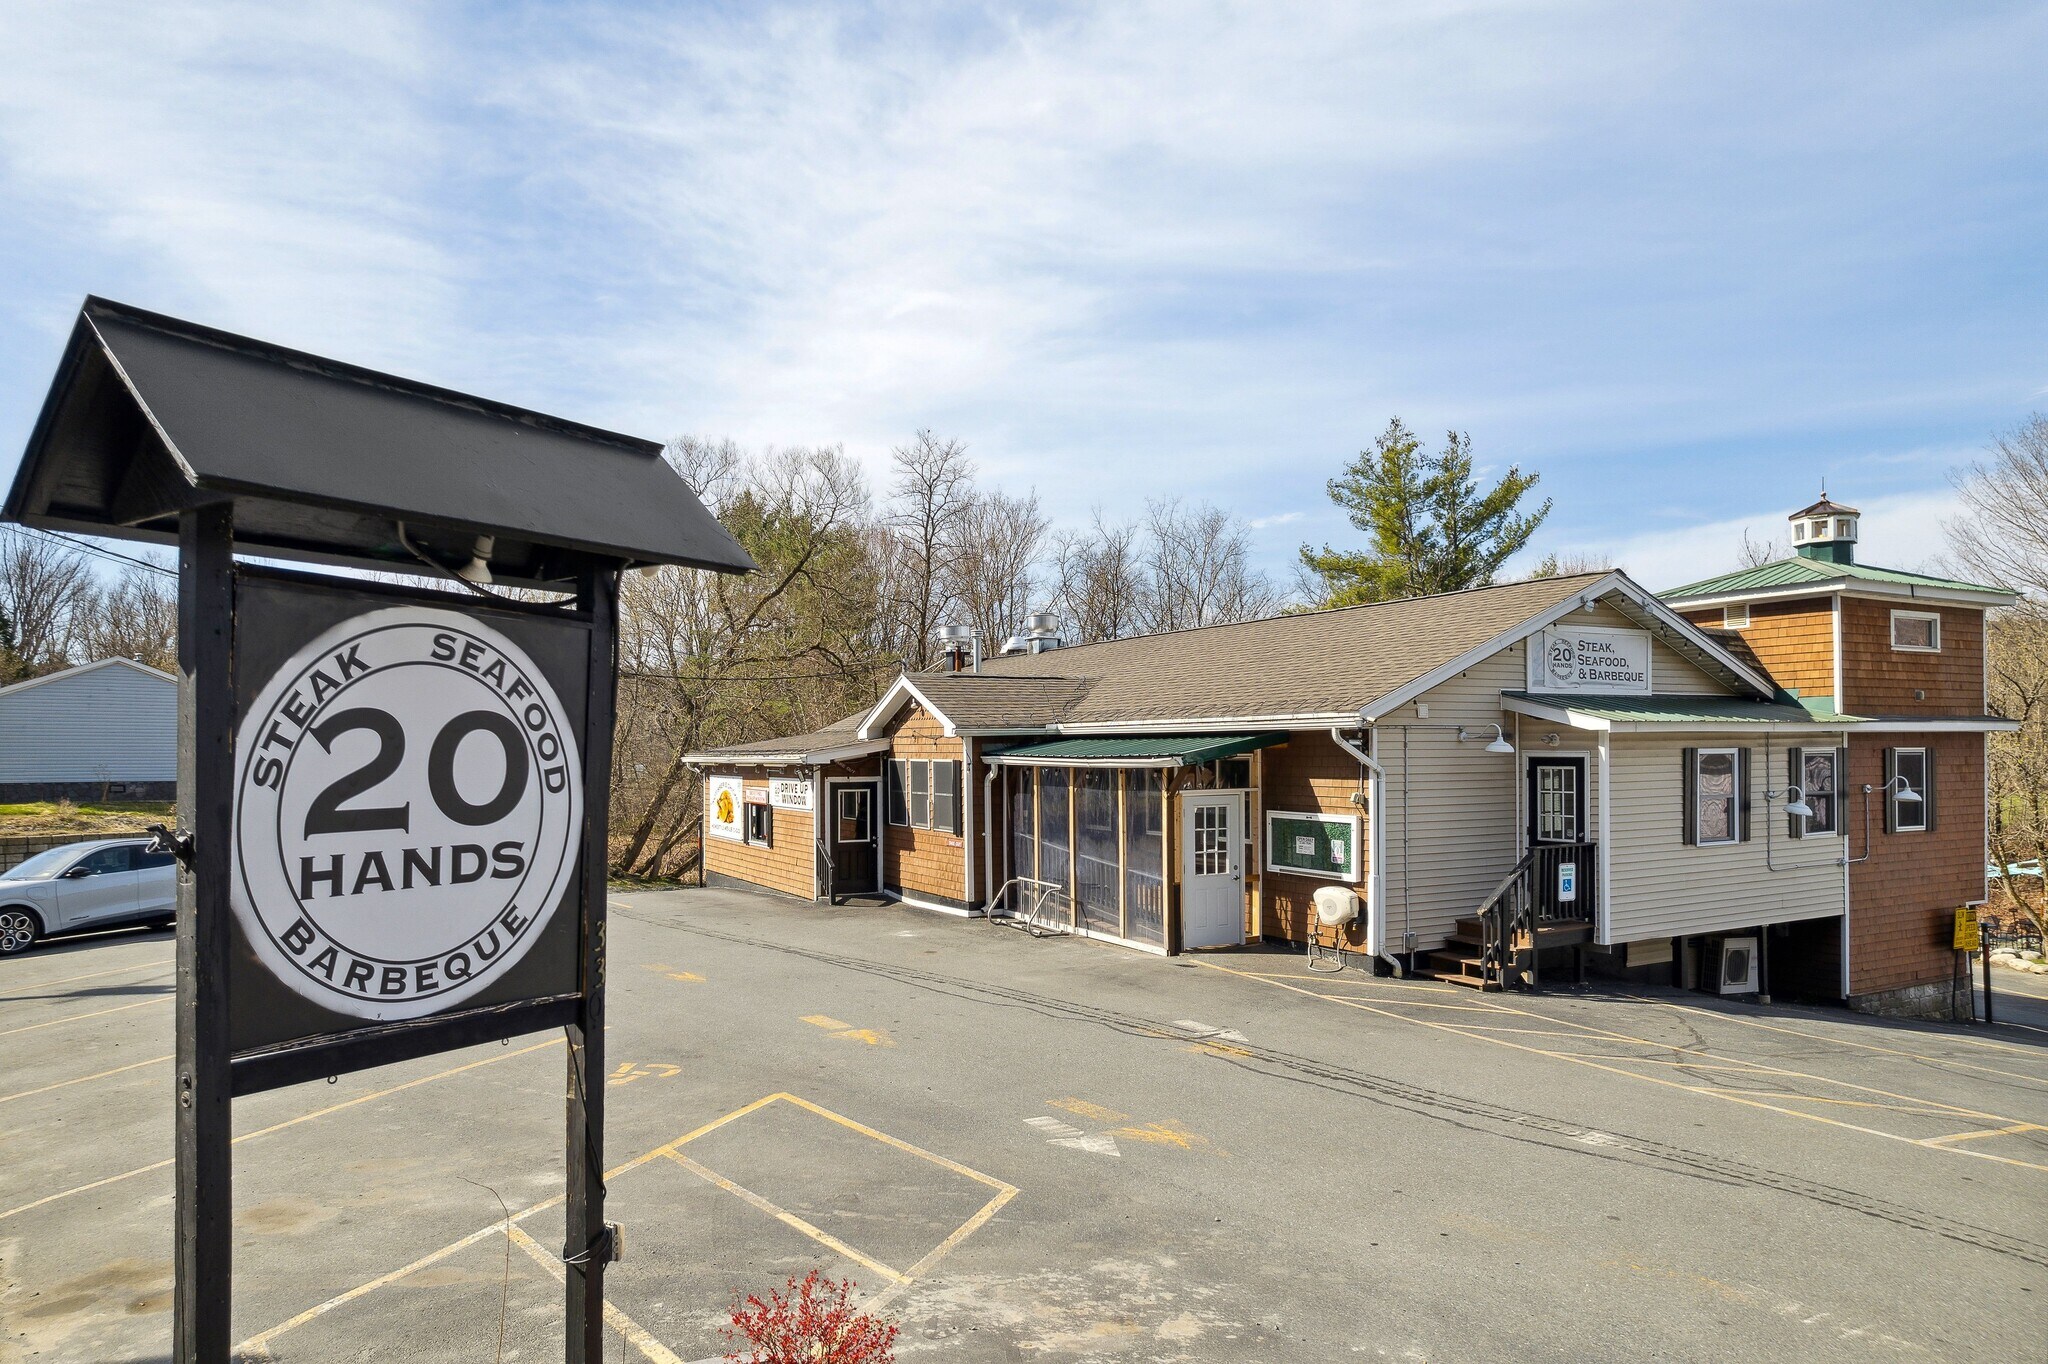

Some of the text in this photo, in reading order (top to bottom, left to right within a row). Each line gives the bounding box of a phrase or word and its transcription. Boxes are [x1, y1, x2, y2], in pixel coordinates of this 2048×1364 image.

[1552, 647, 1572, 662] 20
[1578, 669, 1587, 680] &
[253, 642, 372, 792] STEAK
[430, 632, 566, 795] SEAFOOD
[303, 707, 530, 841] 20
[781, 782, 809, 795] DRIVE UP
[781, 794, 806, 806] WINDOW
[299, 840, 526, 900] HANDS
[278, 904, 530, 996] BARBEQUE
